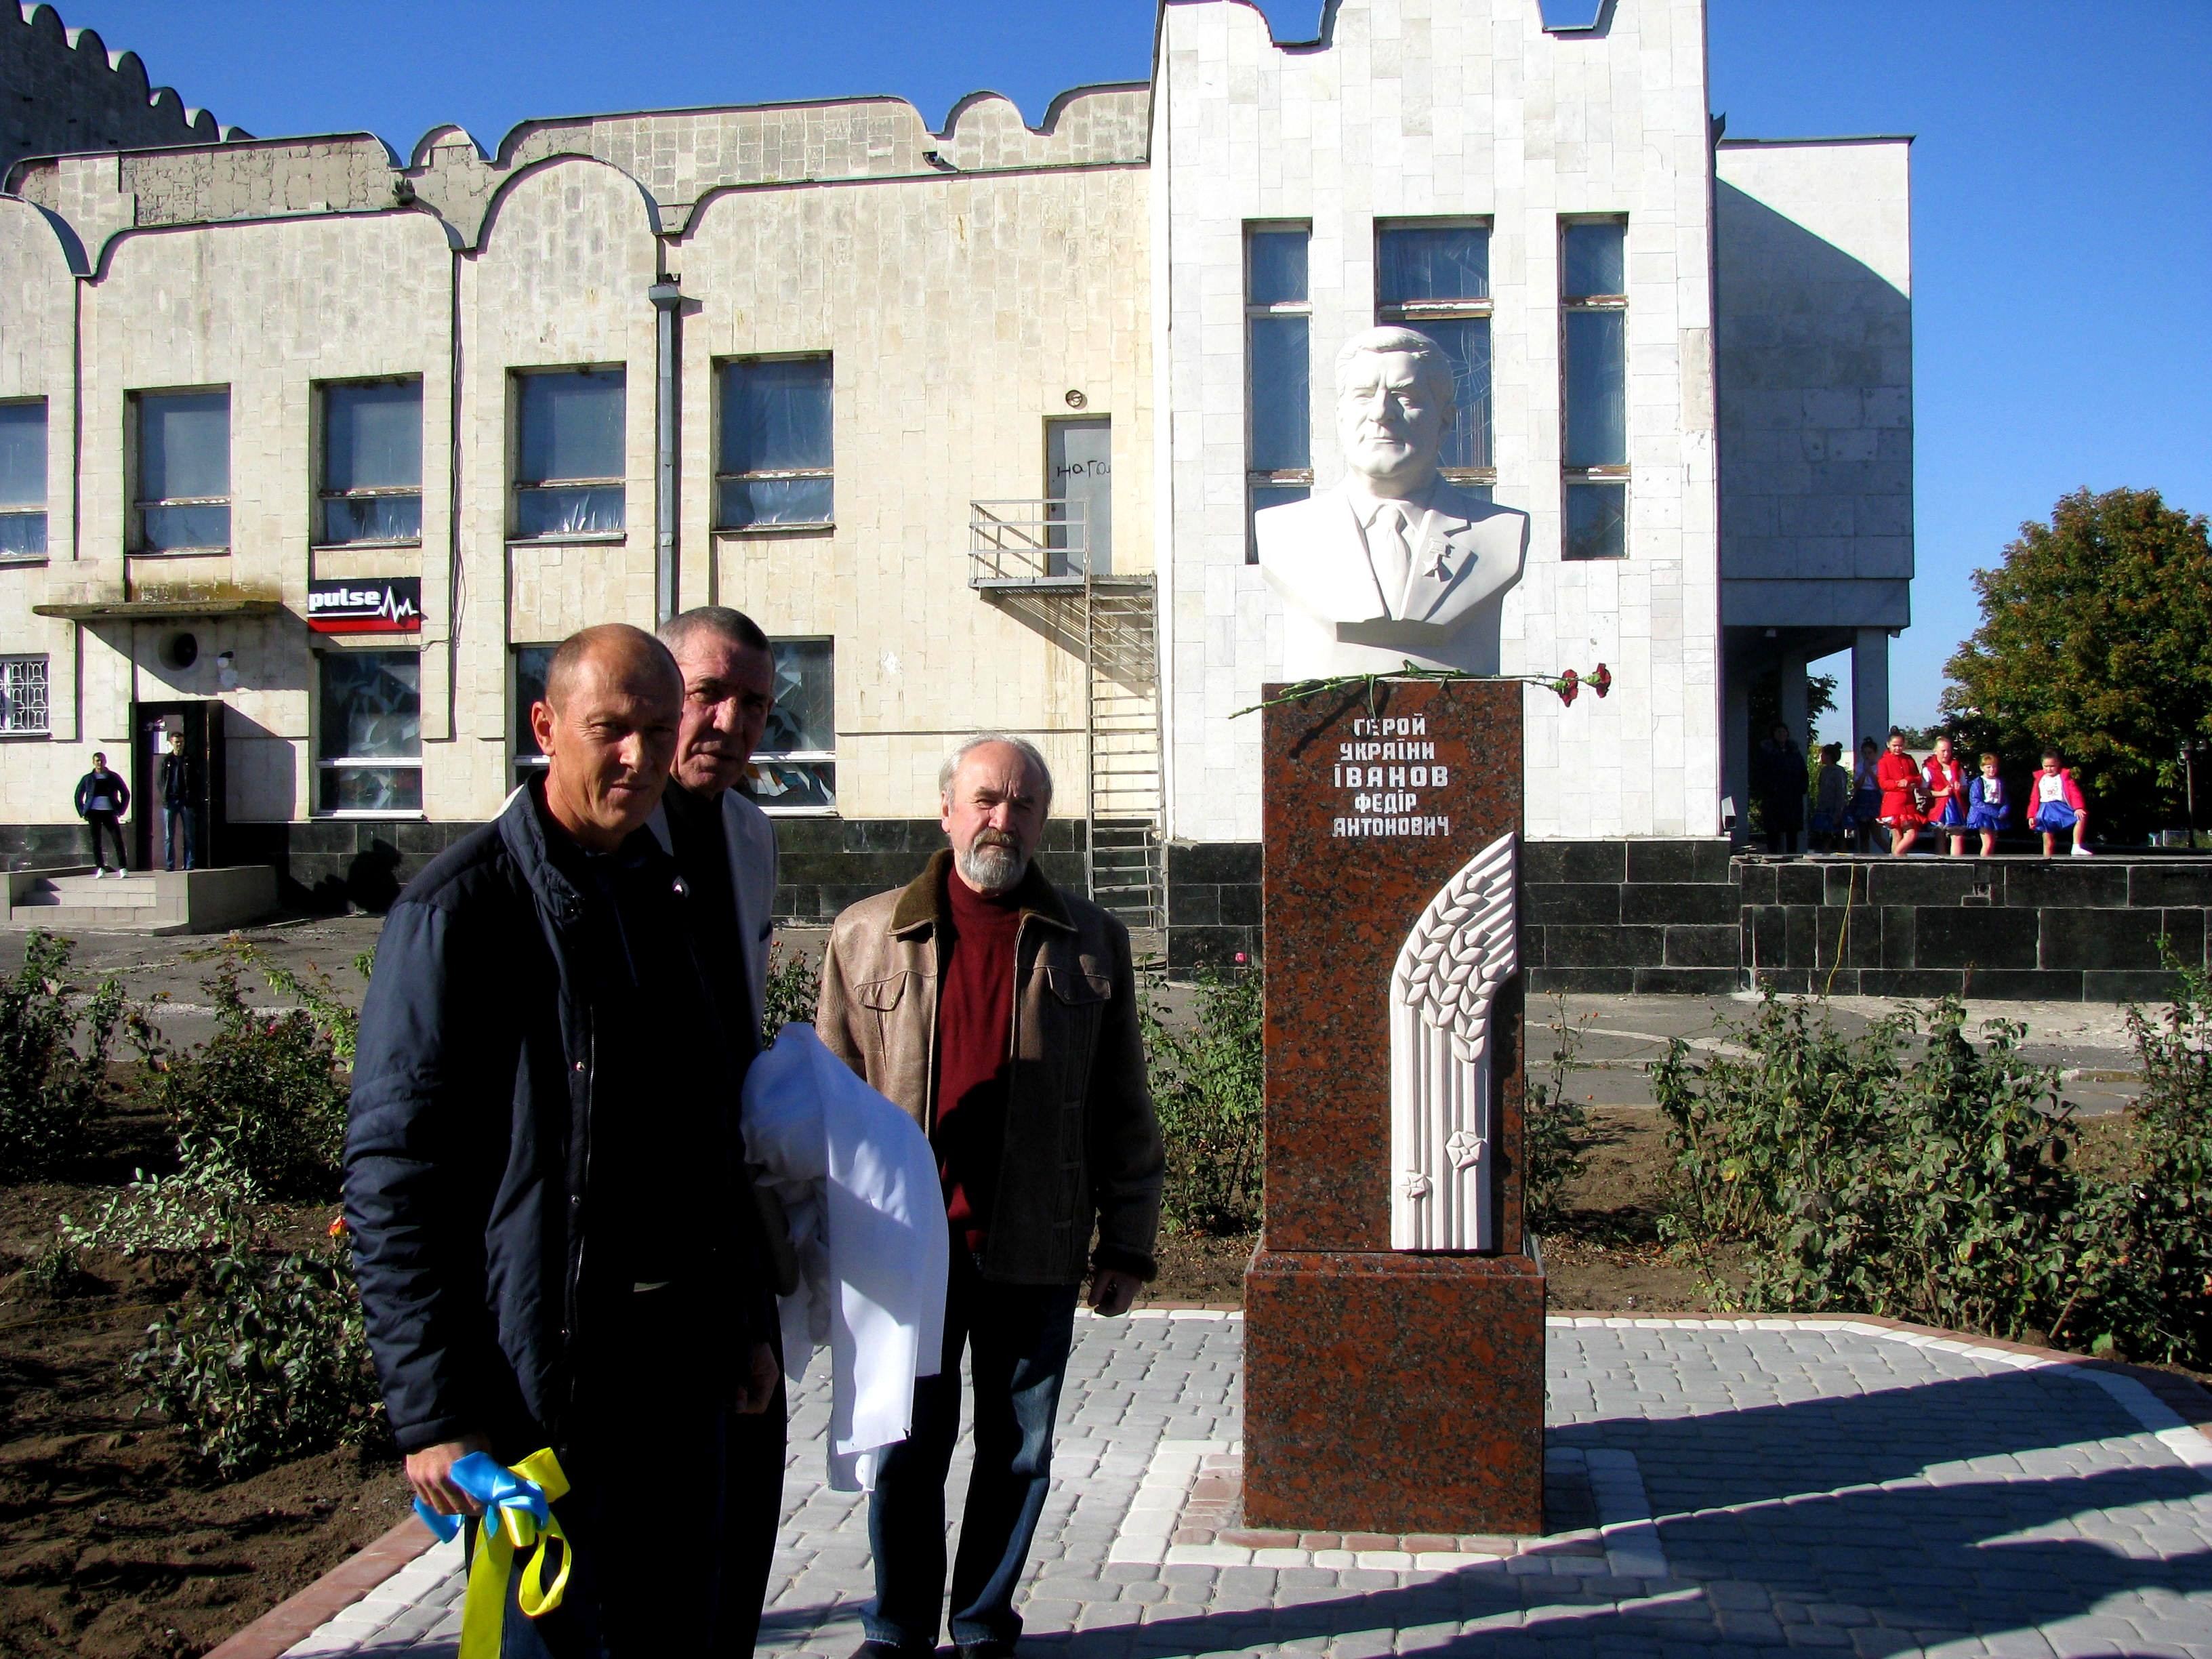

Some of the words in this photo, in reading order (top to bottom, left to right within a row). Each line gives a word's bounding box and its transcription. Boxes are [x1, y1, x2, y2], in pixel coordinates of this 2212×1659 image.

[308, 588, 381, 611] pulse
[1353, 713, 1425, 736] ГЕРОЙ
[1340, 738, 1435, 760] УКРАЇНИ
[1354, 789, 1416, 813] ФЕДІР
[1332, 816, 1449, 837] АНТОНОВИЧ
